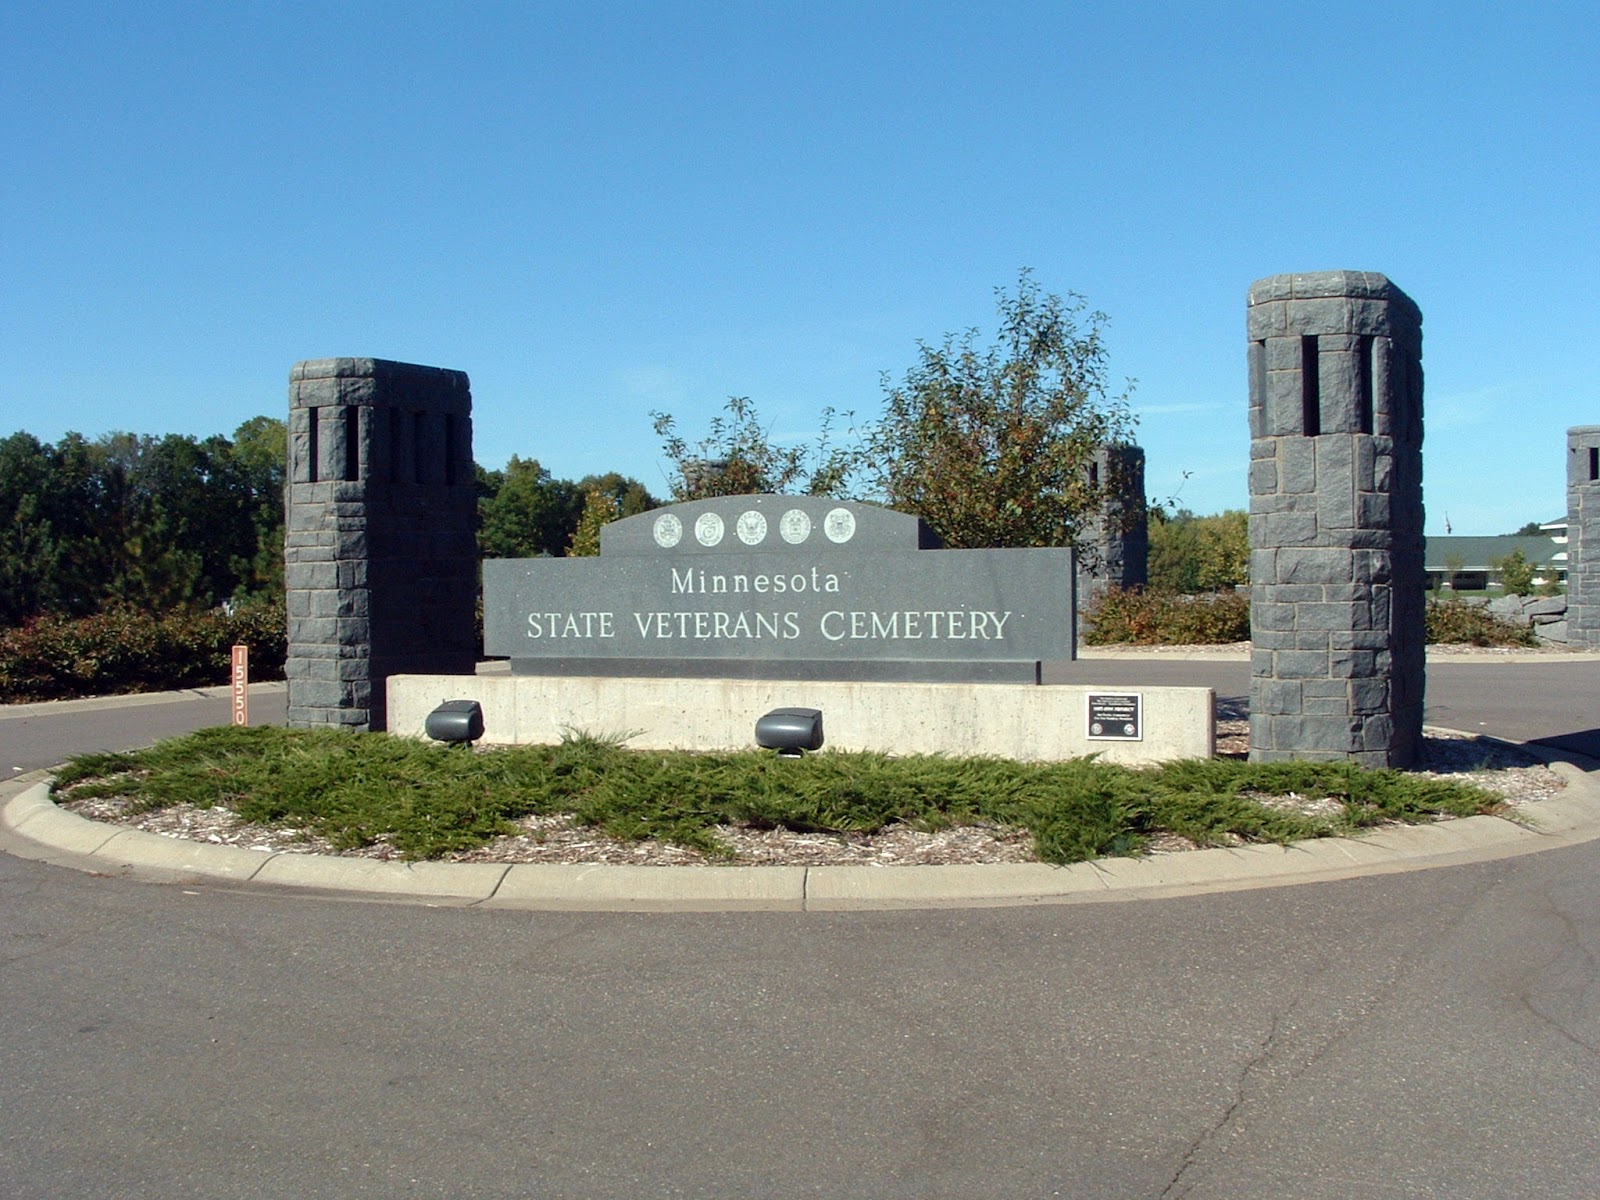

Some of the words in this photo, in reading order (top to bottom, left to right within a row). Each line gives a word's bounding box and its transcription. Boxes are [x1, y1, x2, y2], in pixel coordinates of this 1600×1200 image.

[670, 566, 841, 595] Minnesota
[525, 611, 616, 640] STATE
[633, 611, 801, 641] VETERANS
[820, 609, 1012, 643] CEMETERY
[235, 650, 245, 725] 15550
